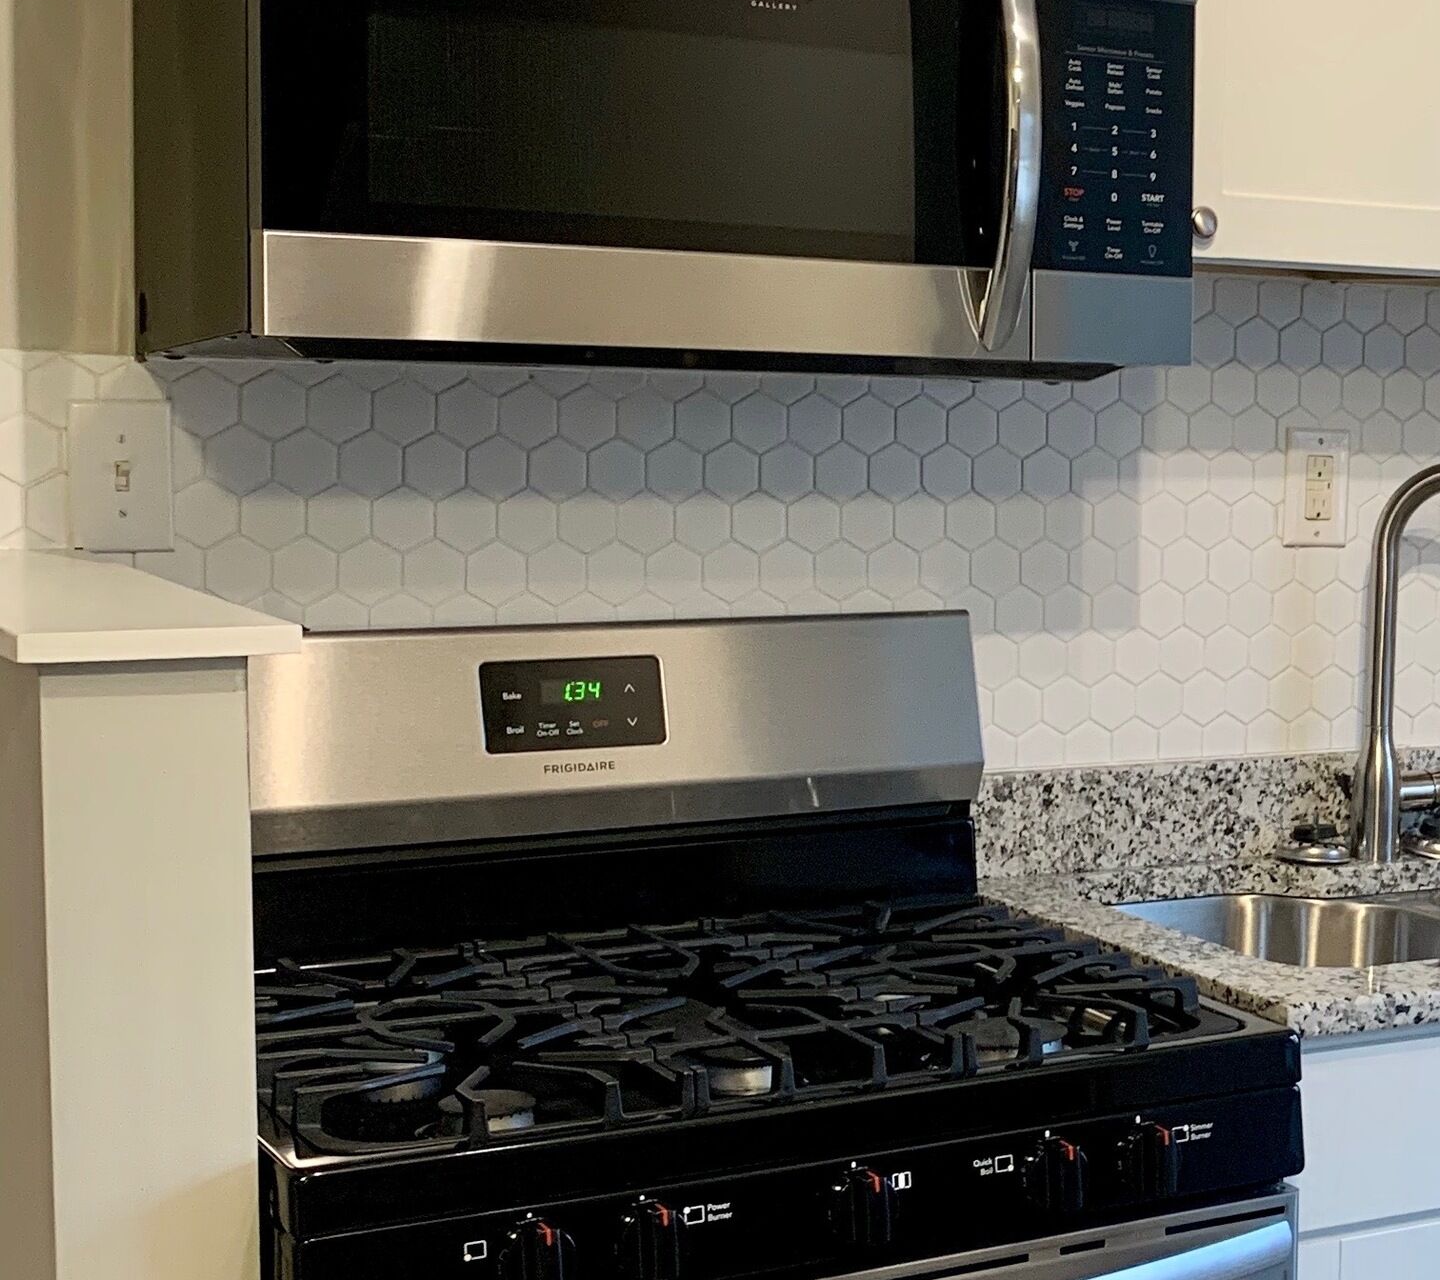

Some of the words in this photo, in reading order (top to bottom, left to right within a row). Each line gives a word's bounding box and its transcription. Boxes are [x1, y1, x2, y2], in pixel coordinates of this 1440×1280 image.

[751, 0, 797, 11] GALLERY
[1071, 122, 1077, 131] 1
[1111, 125, 1118, 135] 2
[1149, 129, 1157, 139] 3
[1071, 143, 1078, 153] 4
[1111, 146, 1118, 156] 5
[1149, 150, 1157, 160] 6
[1071, 166, 1078, 176] 7
[1111, 169, 1118, 179] 8
[1149, 172, 1157, 182] 9
[1063, 187, 1085, 197] STOP
[1111, 192, 1118, 202] 0
[1141, 193, 1165, 203] START
[502, 692, 522, 701] Bake
[538, 722, 557, 730] Timer
[569, 720, 580, 728] Set
[506, 725, 525, 735] Broil
[536, 729, 560, 738] On-Off
[543, 760, 616, 774] FRIGIDAIRE
[973, 1158, 993, 1168] Quick
[707, 1202, 731, 1212] Power
[708, 1212, 733, 1222] Burner
